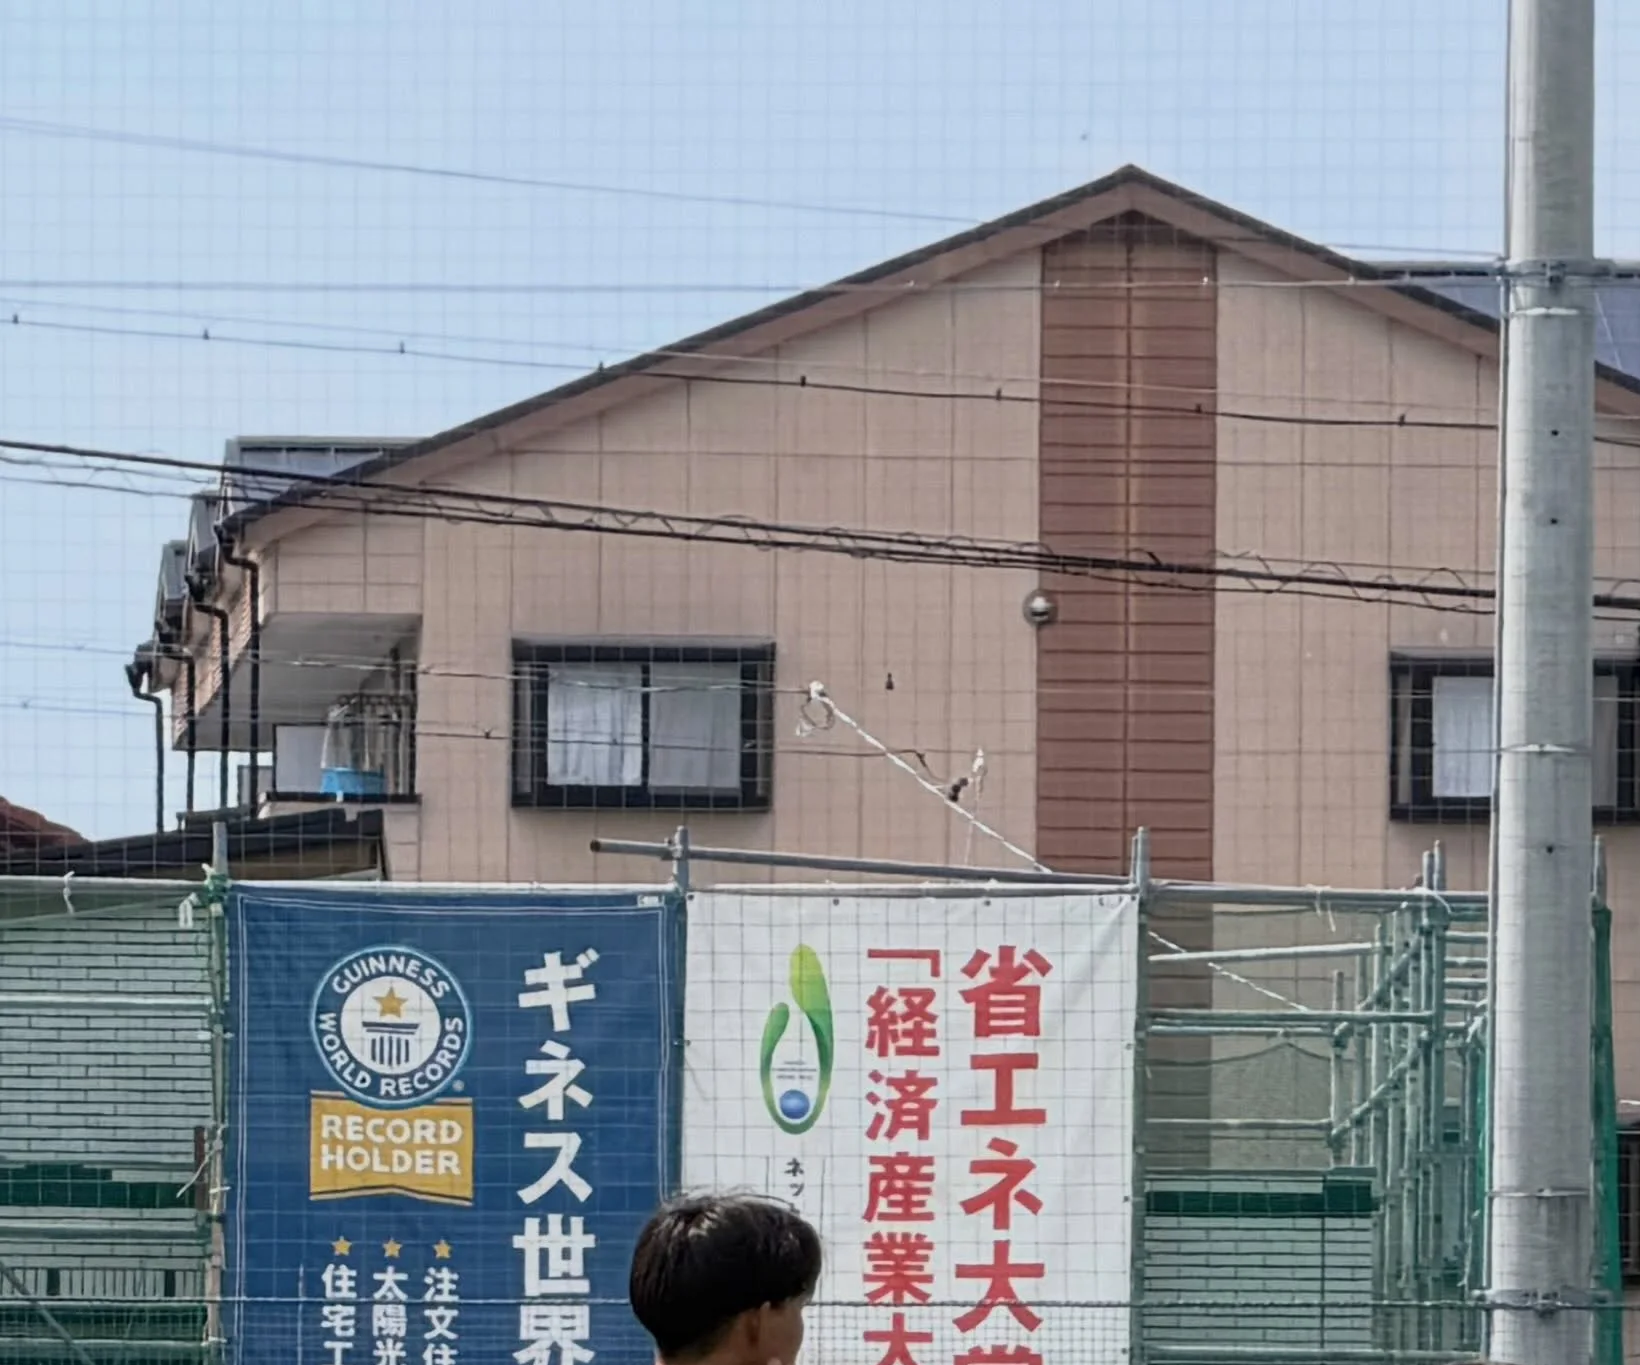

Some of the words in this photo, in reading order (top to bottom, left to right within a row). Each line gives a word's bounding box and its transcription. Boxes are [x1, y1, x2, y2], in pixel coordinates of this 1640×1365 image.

[332, 955, 451, 999] GUINNESS
[318, 1012, 372, 1090] WORLD
[379, 1016, 464, 1097] RECORDS
[321, 1114, 463, 1145] RECORD
[320, 1144, 462, 1176] HOLDER
